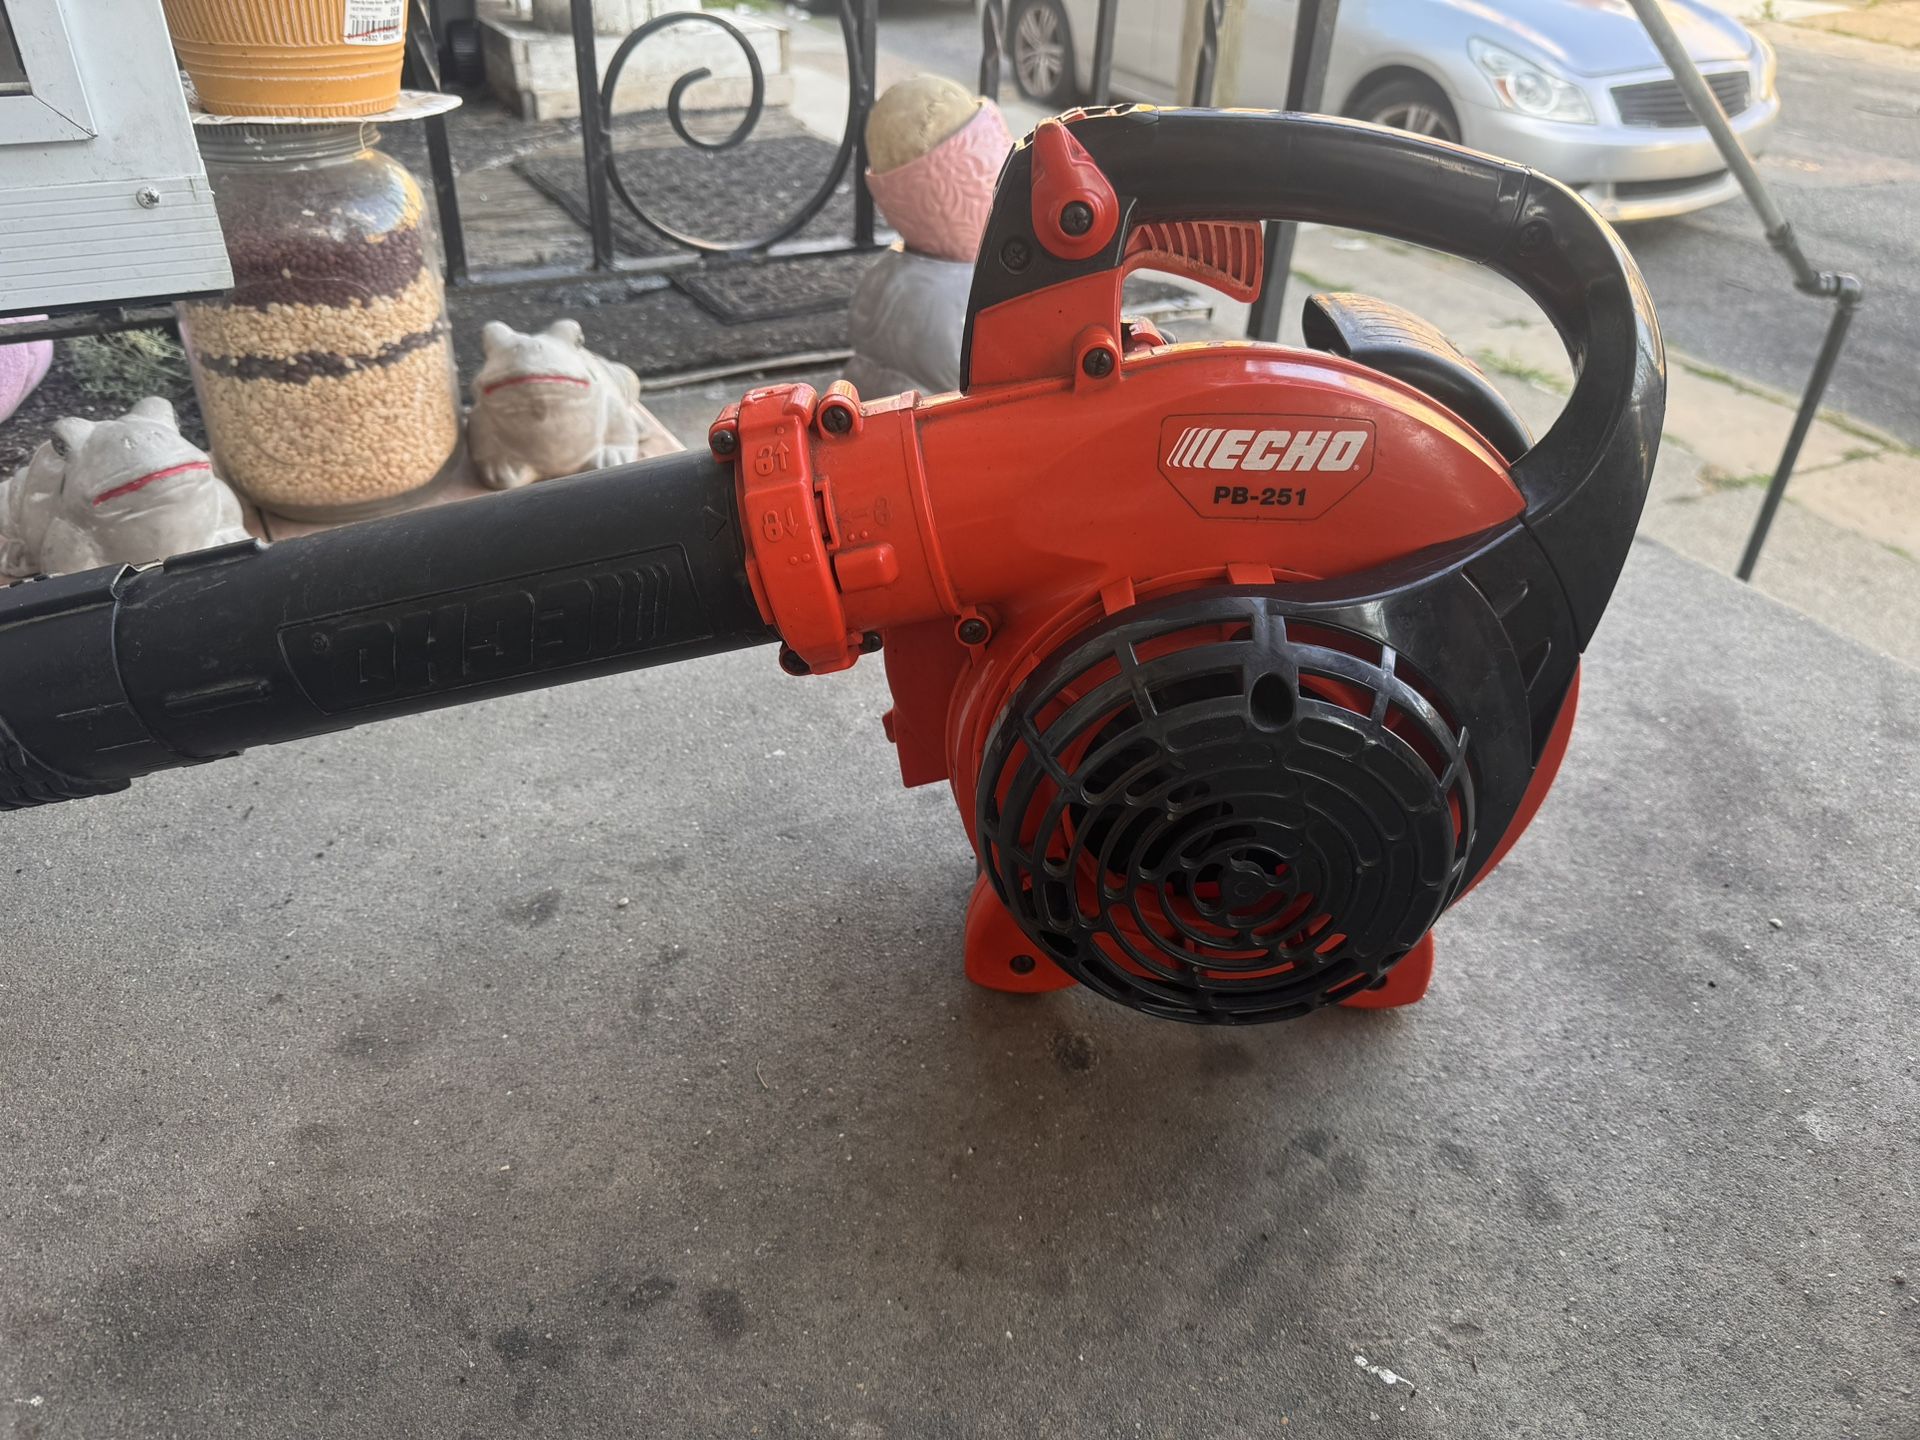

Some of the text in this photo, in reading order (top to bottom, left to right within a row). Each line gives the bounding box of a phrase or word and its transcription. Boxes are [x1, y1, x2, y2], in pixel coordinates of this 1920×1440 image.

[1208, 429, 1369, 472] ECHO
[1213, 486, 1307, 506] PB-251
[325, 578, 595, 698] ECHO
